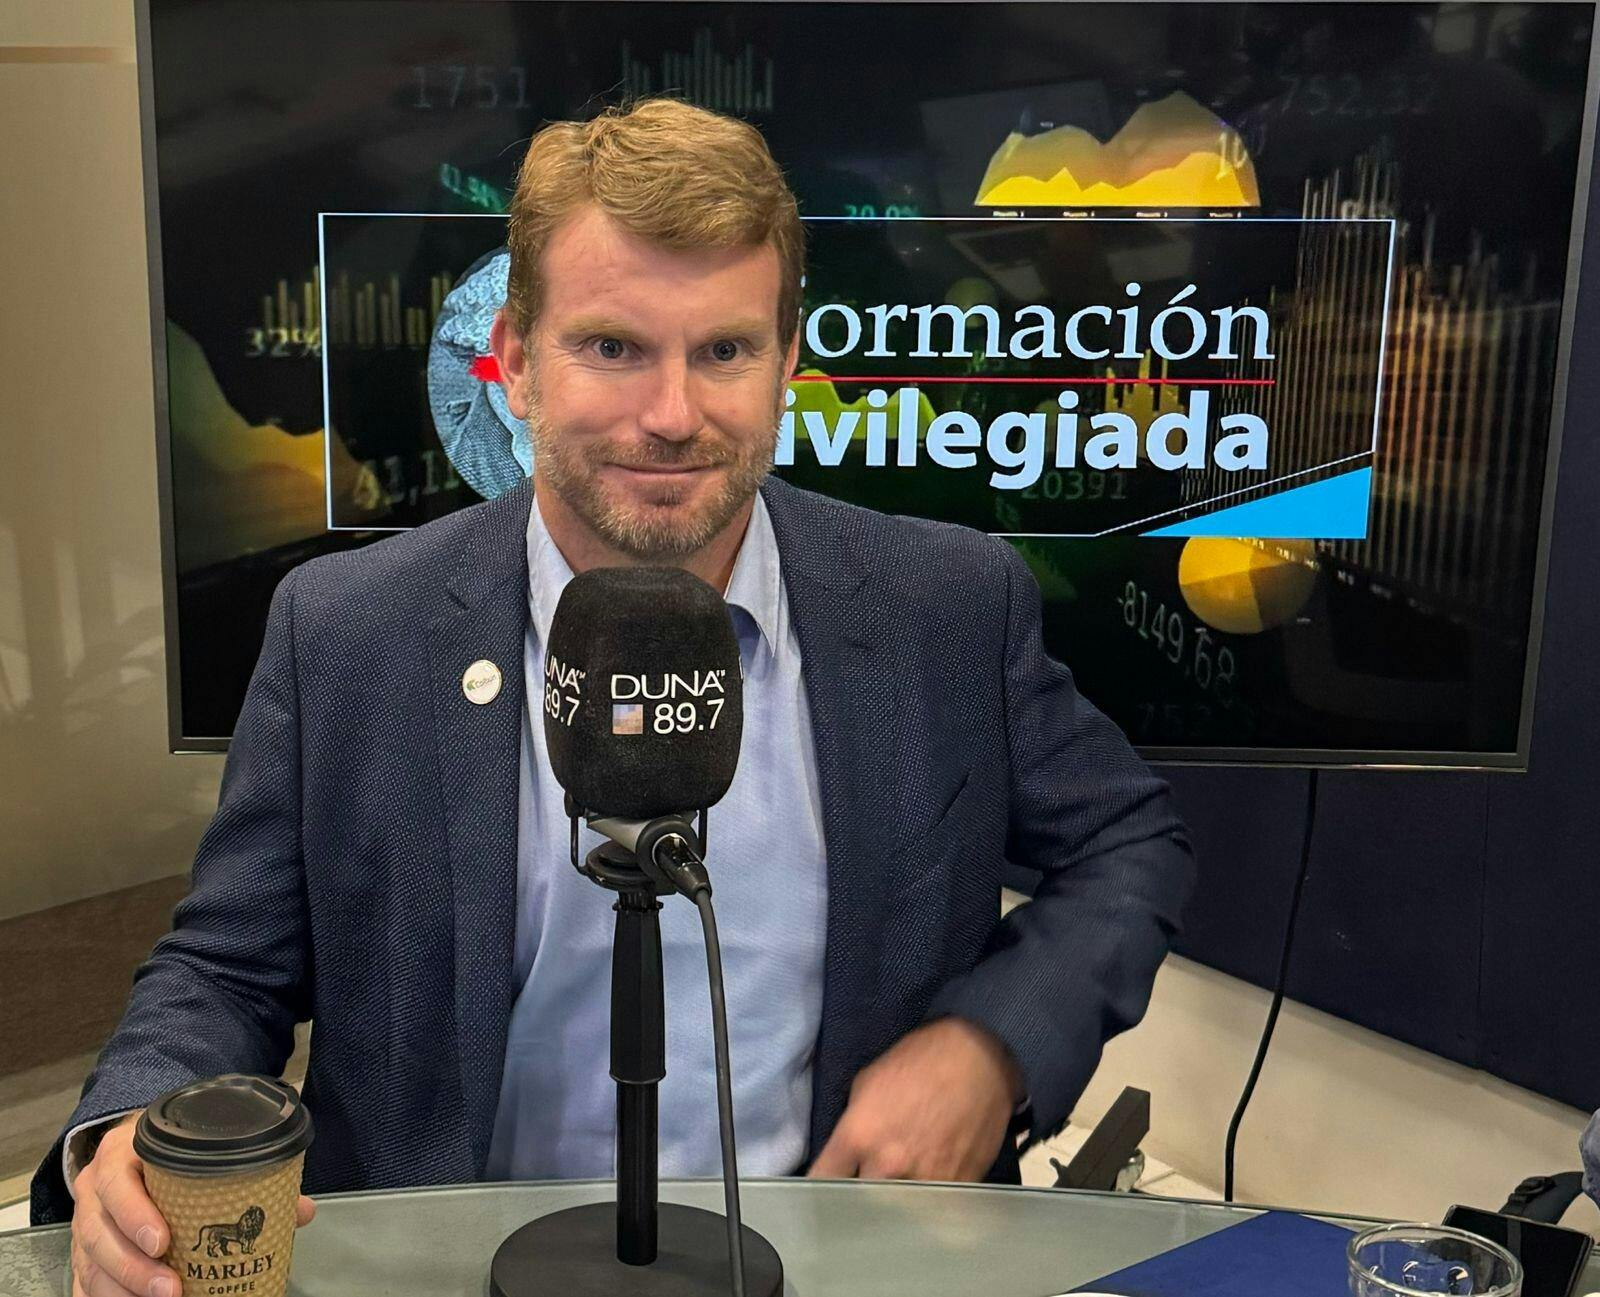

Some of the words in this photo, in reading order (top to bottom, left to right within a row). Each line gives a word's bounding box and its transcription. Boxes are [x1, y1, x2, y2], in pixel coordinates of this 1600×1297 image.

[800, 278, 1276, 361] ormación
[775, 387, 1268, 490] ivilegiada
[545, 655, 586, 695] UNA
[653, 698, 725, 735] 89.7
[187, 1252, 276, 1281] MARLEY
[208, 1281, 256, 1295] COFFEE
